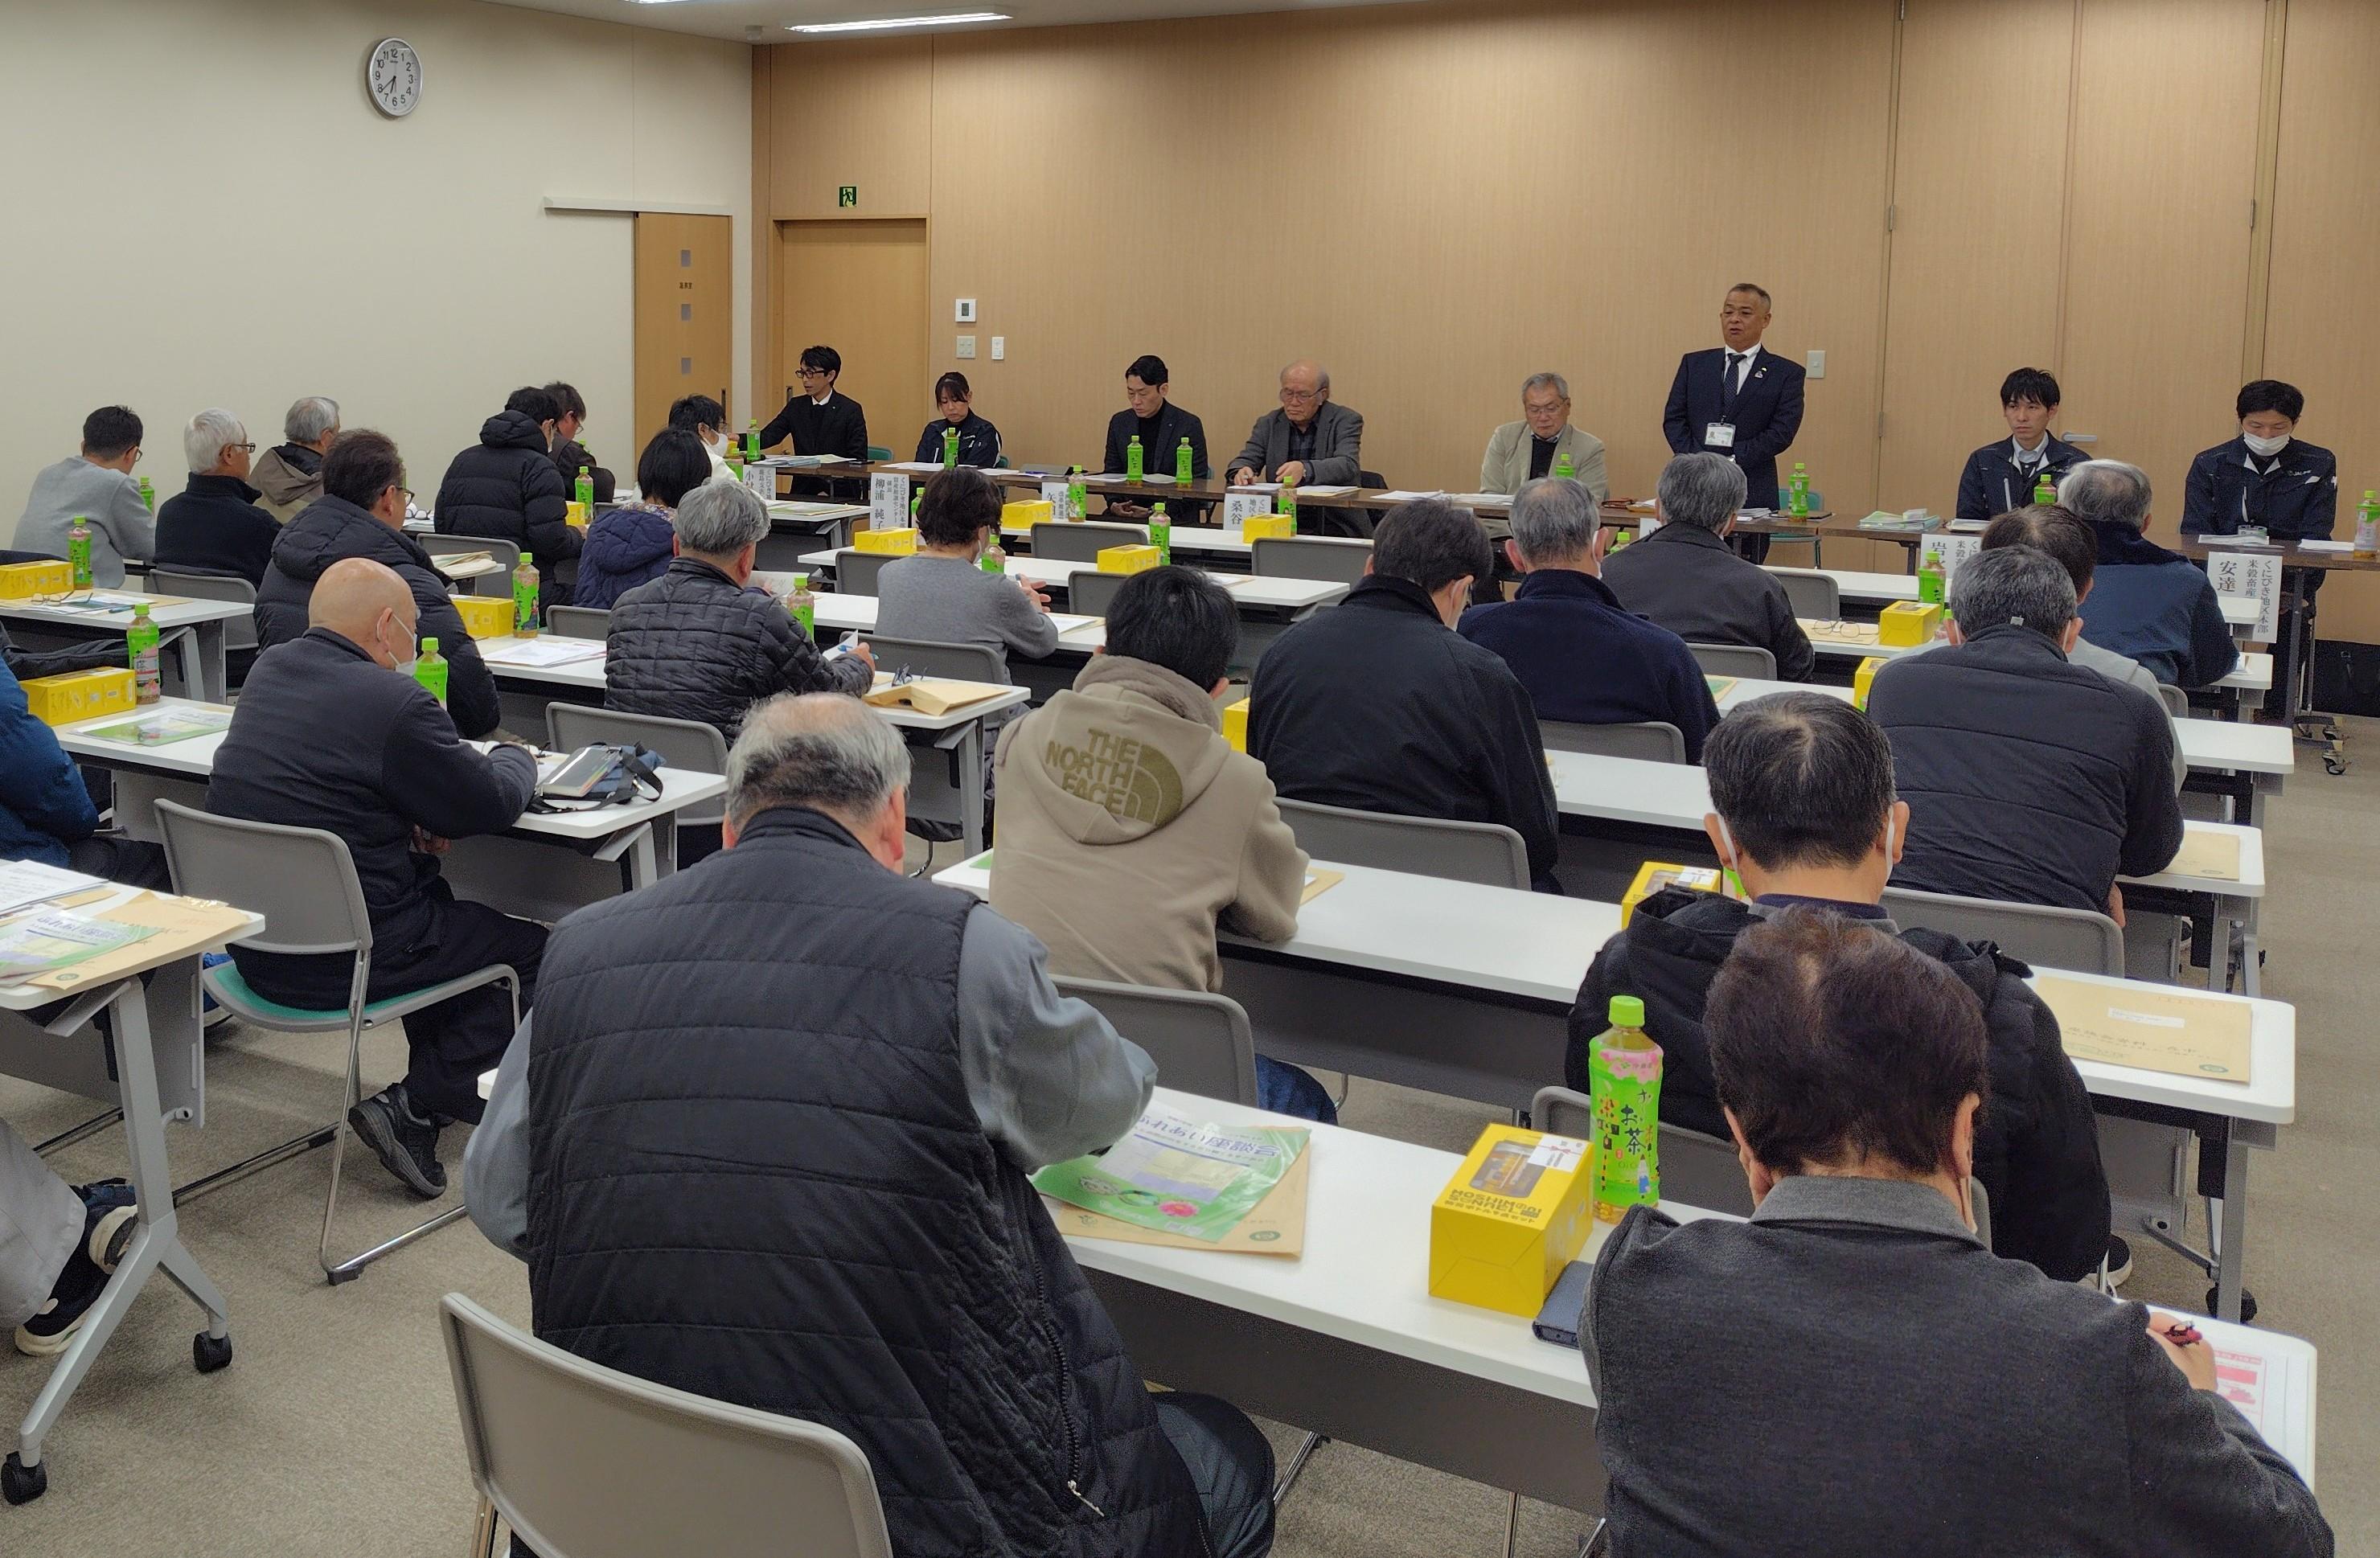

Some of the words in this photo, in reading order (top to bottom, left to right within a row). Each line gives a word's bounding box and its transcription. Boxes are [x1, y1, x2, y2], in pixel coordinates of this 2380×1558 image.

[384, 51, 389, 59] 11
[391, 48, 398, 58] 12
[377, 59, 384, 68] 10
[406, 62, 412, 72] 2
[375, 71, 380, 80] 9
[408, 75, 413, 84] 3
[378, 84, 384, 93] 8
[406, 87, 412, 95] 4
[384, 93, 389, 102] 7
[392, 96, 398, 106] 6
[400, 95, 406, 104] 5
[1231, 500, 1243, 525] 桑谷
[2218, 561, 2237, 592] 安達
[2258, 560, 2272, 633] くにびき地区本部
[1088, 728, 1139, 765] THE
[1045, 740, 1134, 793] NORTH
[1061, 773, 1127, 815] FACE
[1621, 1104, 1647, 1155] お茶
